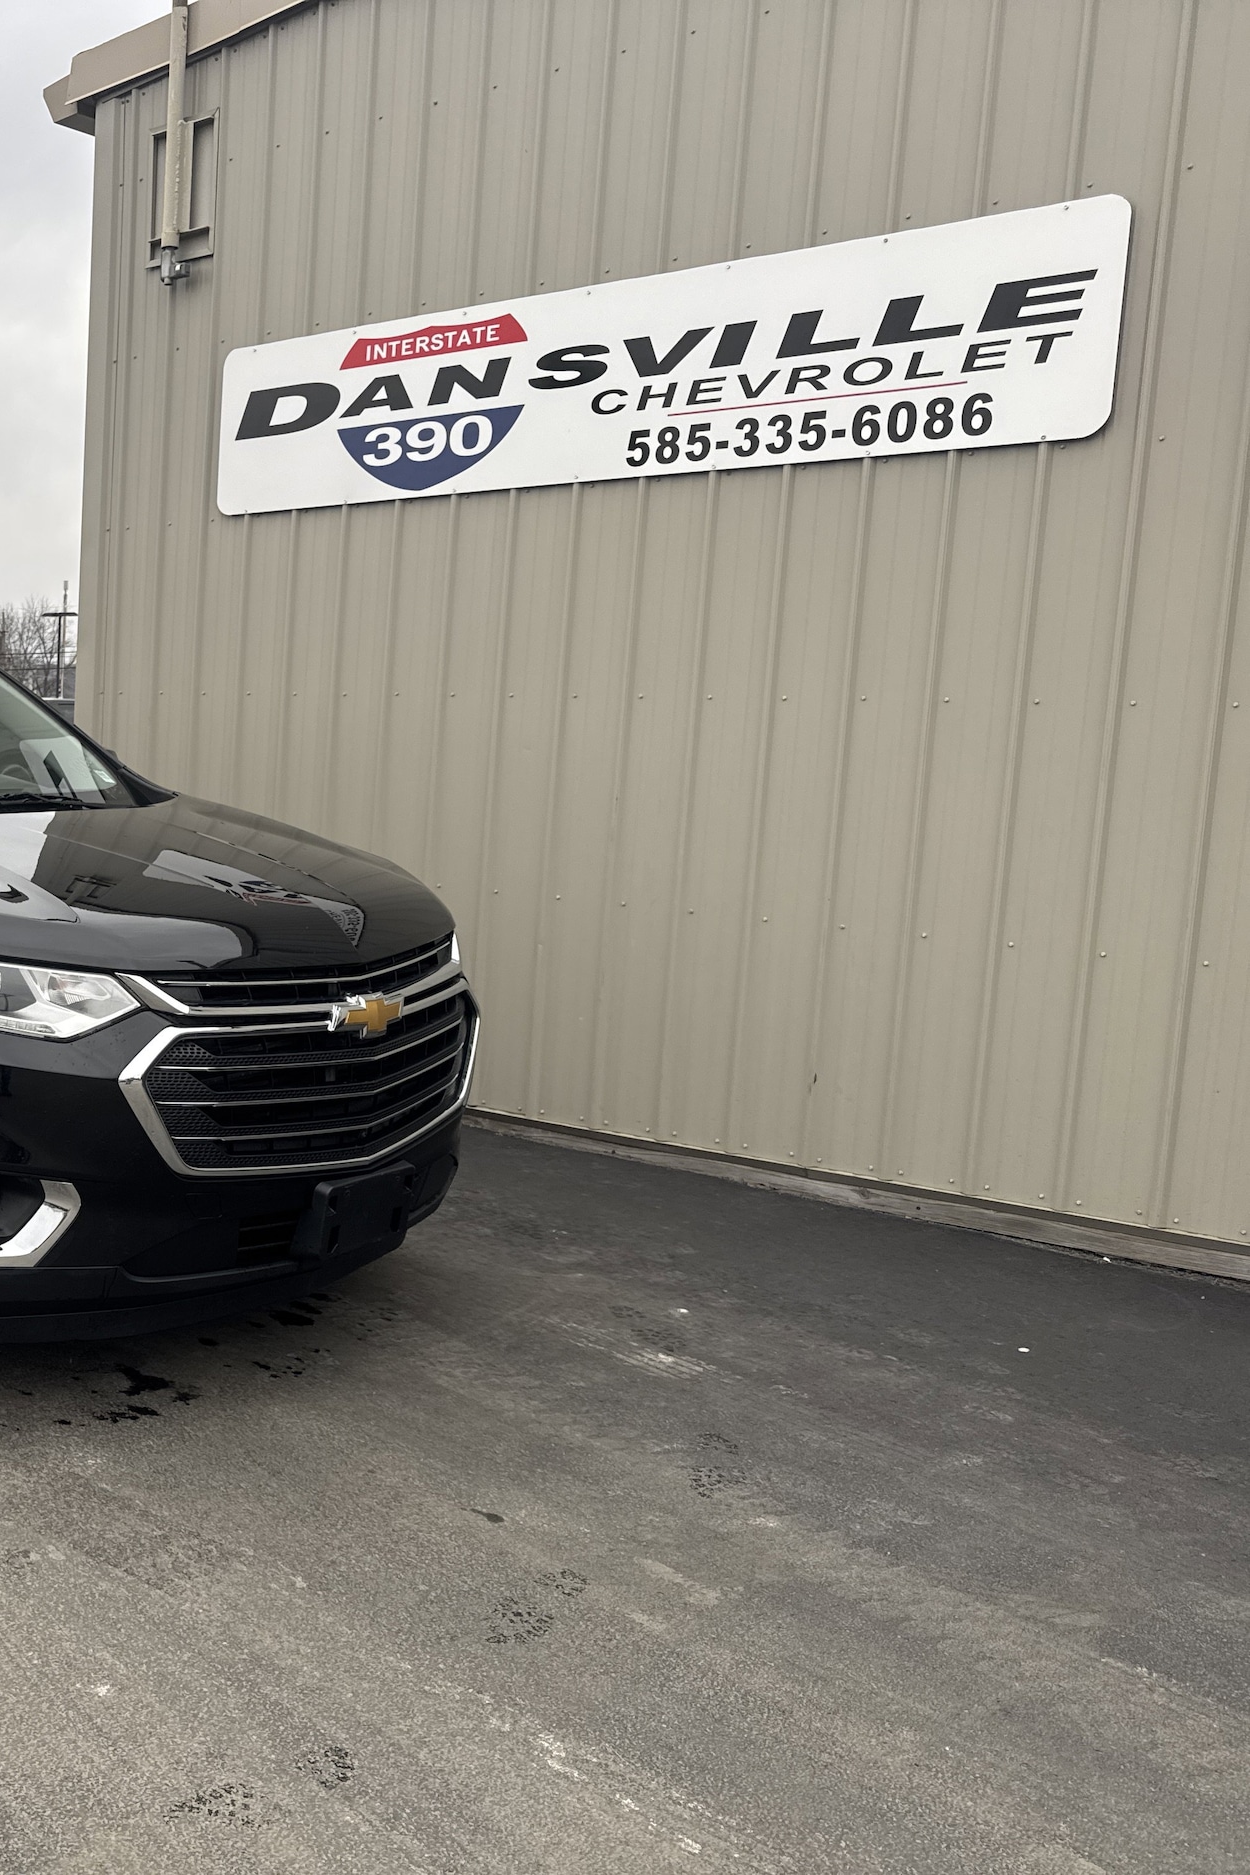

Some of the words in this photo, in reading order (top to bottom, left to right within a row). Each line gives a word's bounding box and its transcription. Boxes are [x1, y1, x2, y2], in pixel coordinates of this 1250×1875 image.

[235, 269, 1098, 441] DANSVILLE
[365, 324, 500, 362] INTERSTATE
[590, 331, 1073, 415] CHEVROLET
[362, 415, 493, 467] 390
[625, 392, 994, 467] 585-335-6086
